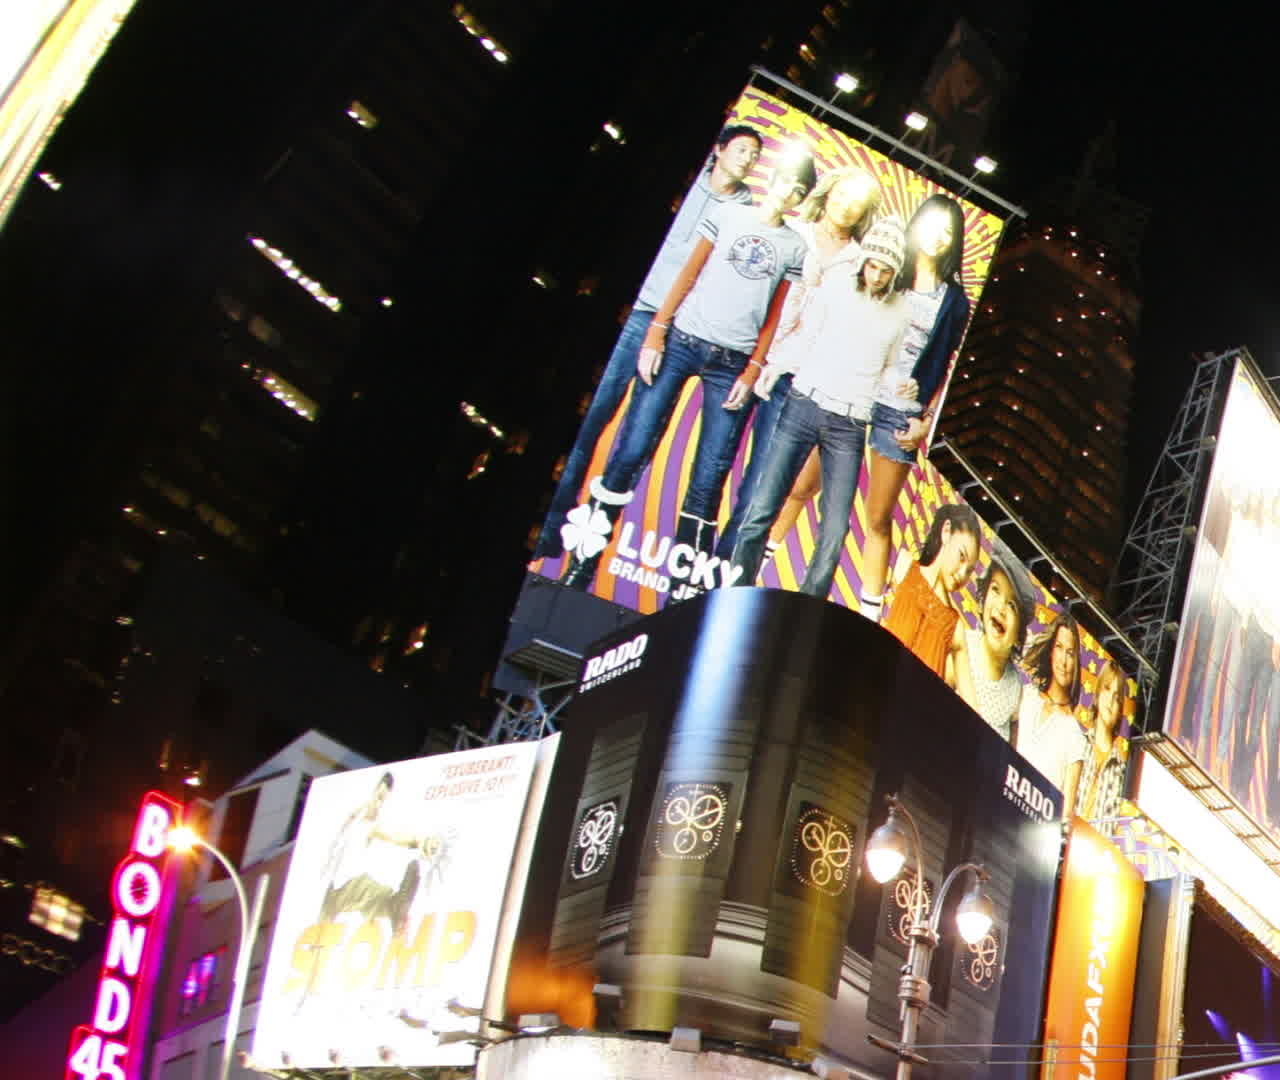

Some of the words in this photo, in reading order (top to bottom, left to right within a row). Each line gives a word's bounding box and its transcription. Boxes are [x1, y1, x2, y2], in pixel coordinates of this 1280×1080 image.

[608, 557, 671, 593] BRAND
[616, 521, 744, 591] LUCKY
[583, 634, 648, 682] RADO
[1005, 764, 1055, 821] RADO
[94, 803, 169, 1034] BOND
[281, 910, 477, 993] STOMP
